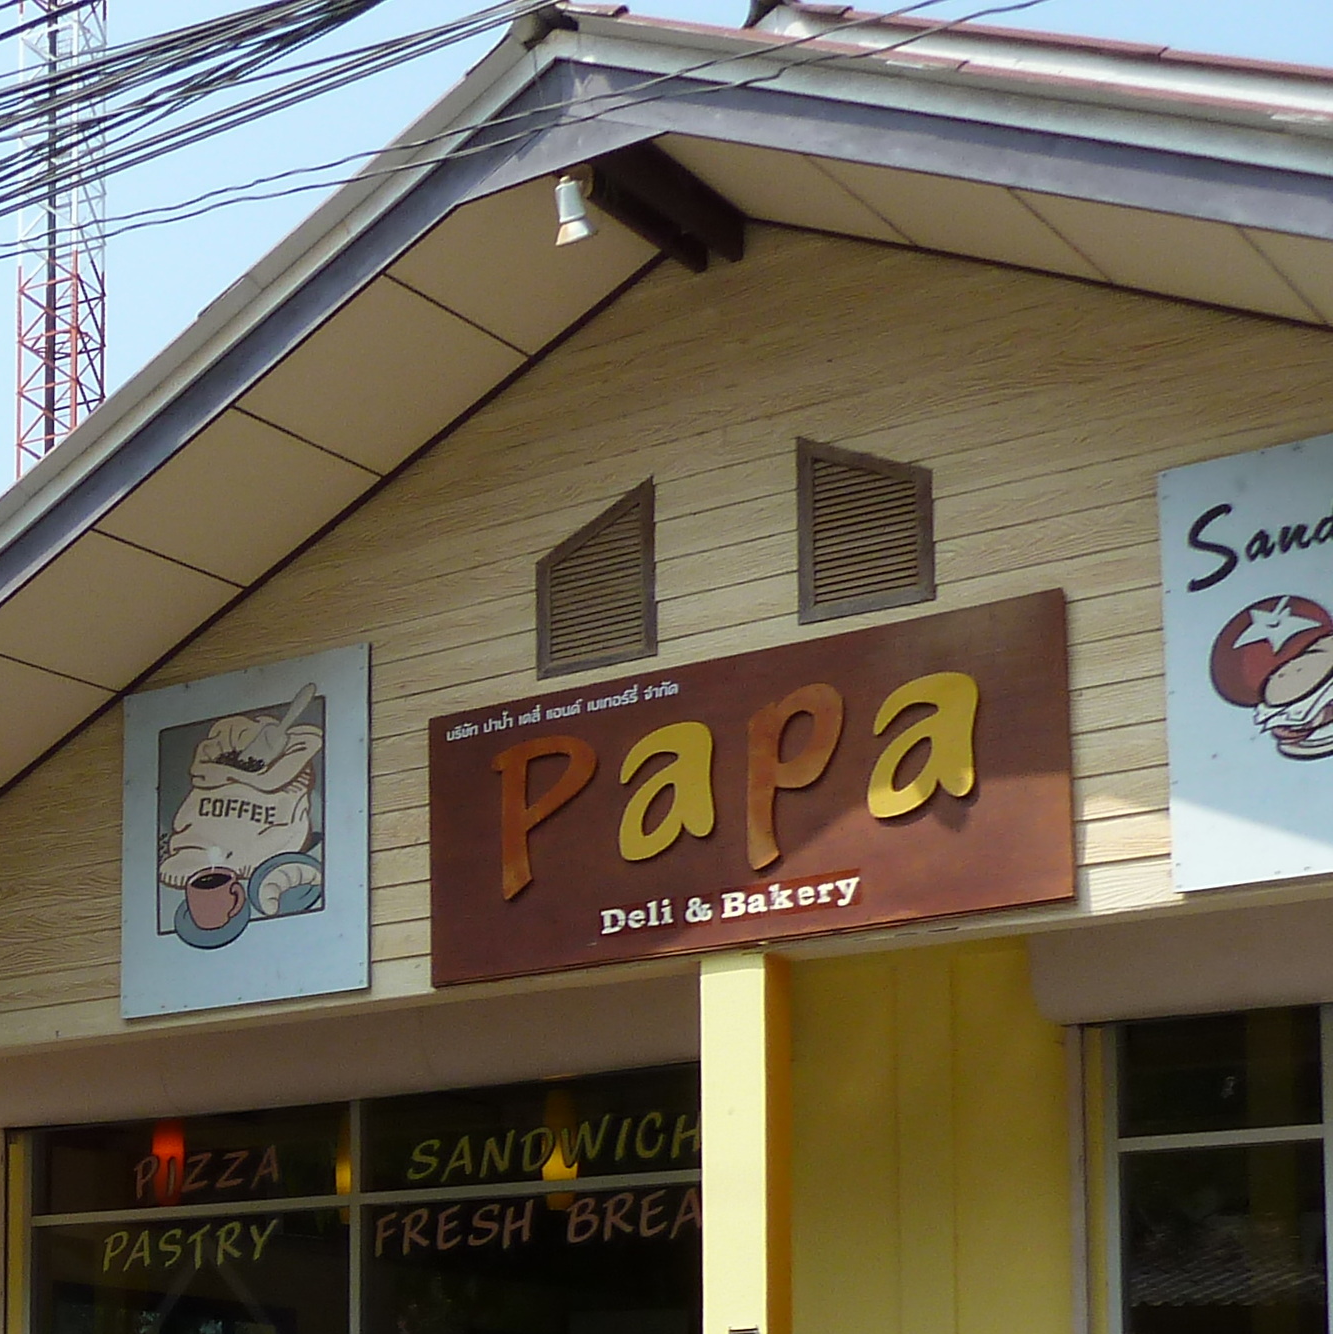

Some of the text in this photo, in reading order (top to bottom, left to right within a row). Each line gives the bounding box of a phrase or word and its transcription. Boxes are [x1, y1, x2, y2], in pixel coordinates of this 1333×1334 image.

[198, 797, 277, 825] COFFEE
[600, 875, 860, 935] Deli & Bakery
[134, 1143, 281, 1200] PIZZA
[103, 1219, 281, 1272] PASTRY
[375, 1200, 534, 1257] FRESH
